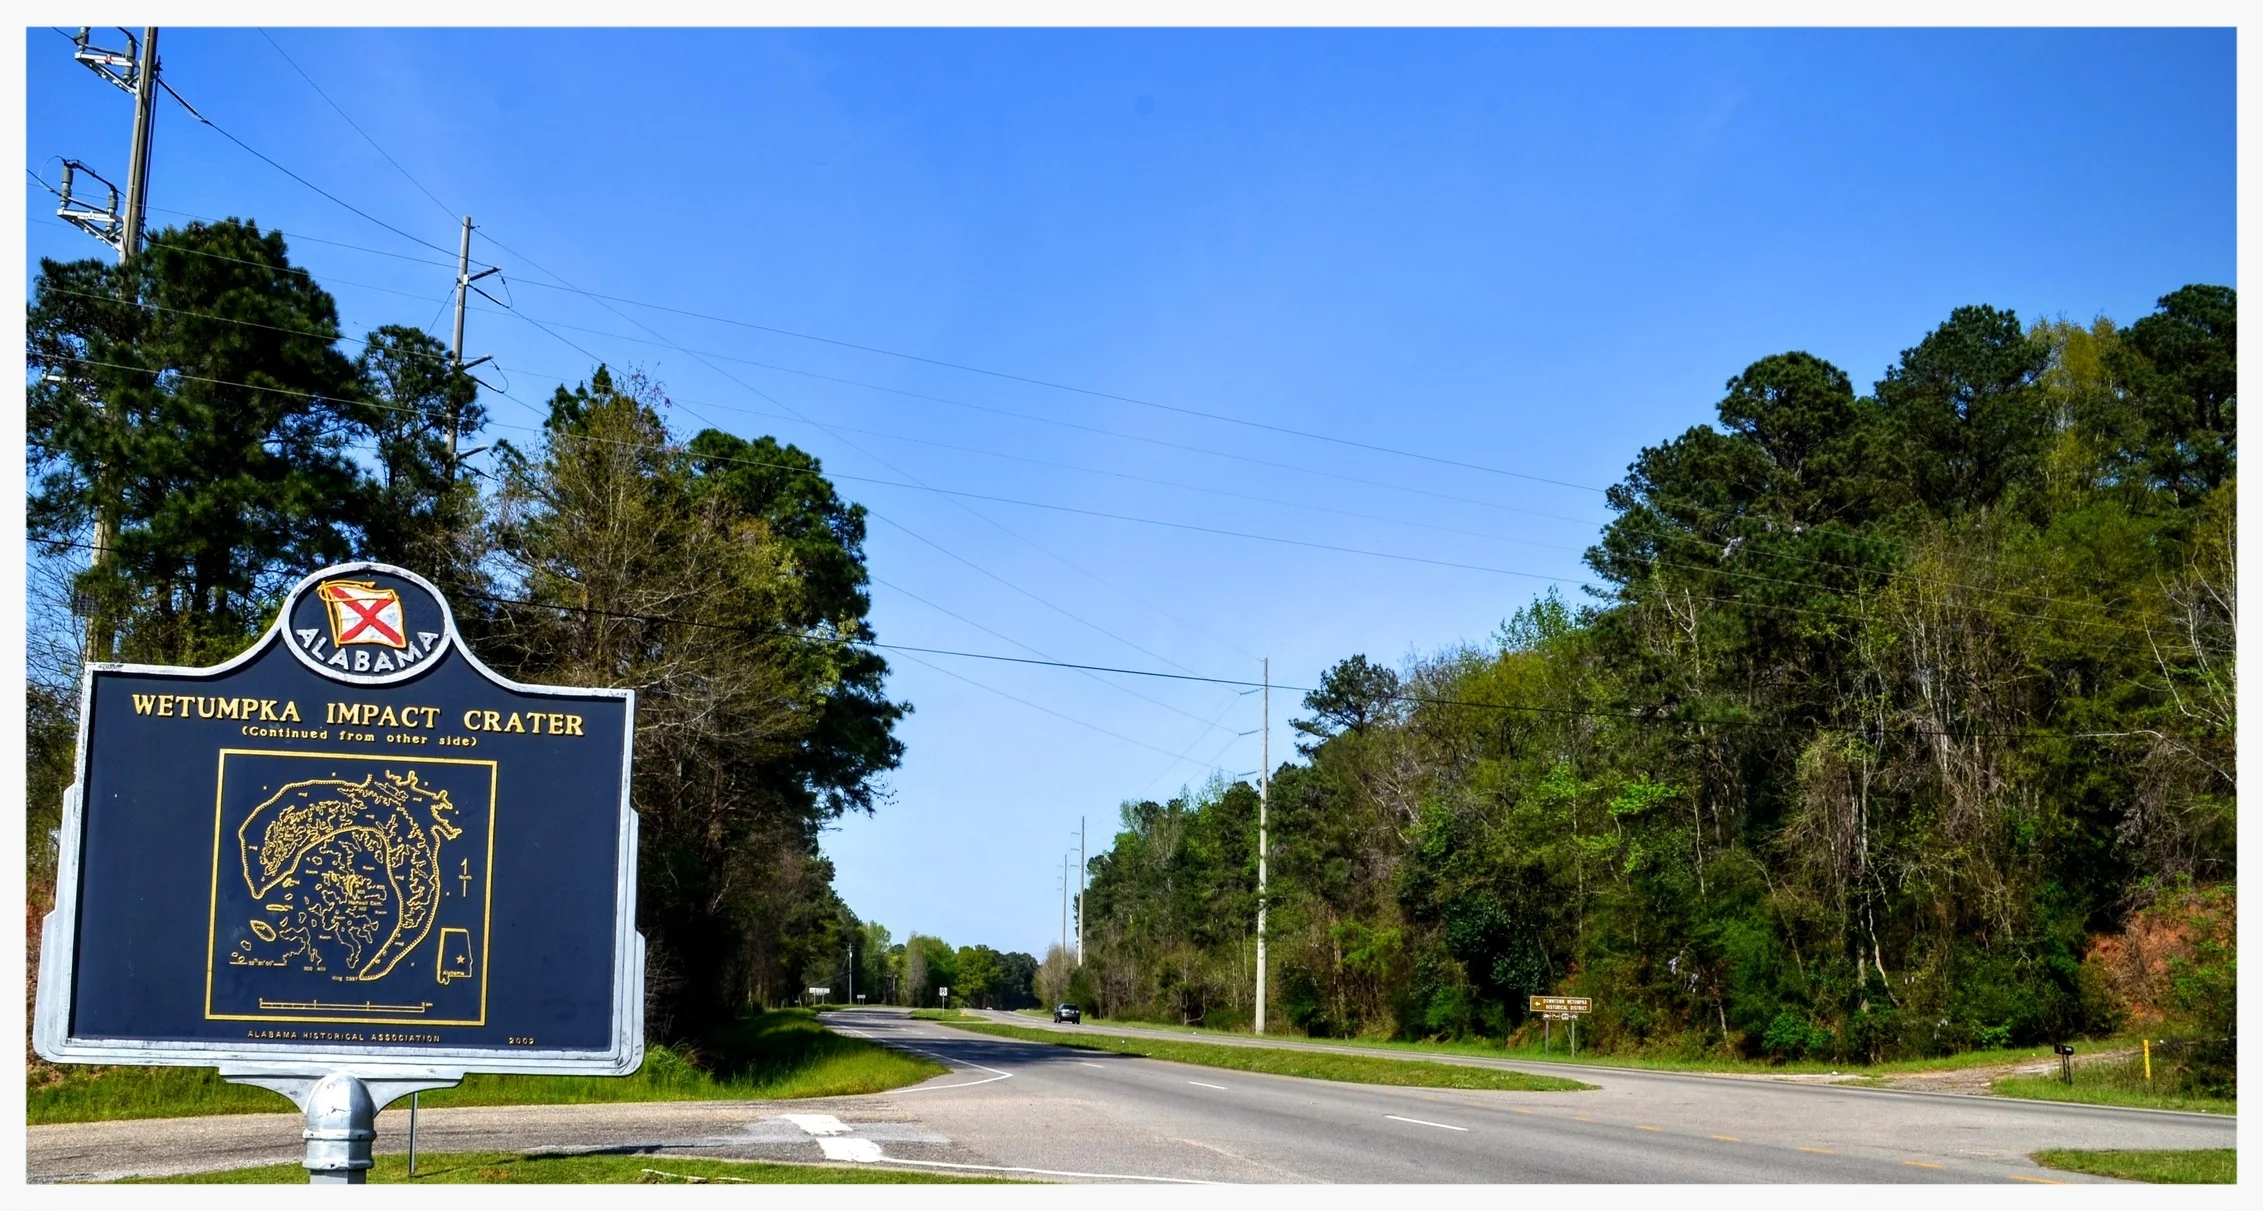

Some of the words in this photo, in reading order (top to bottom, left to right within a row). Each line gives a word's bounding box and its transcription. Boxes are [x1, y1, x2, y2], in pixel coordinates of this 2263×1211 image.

[295, 628, 439, 672] ALABAMA
[132, 693, 302, 723] WETUMPKA
[326, 702, 440, 729] IMPACT
[463, 709, 585, 737] CRATER
[241, 725, 328, 740] (Continued
[339, 730, 375, 742] from
[386, 734, 428, 745] other
[439, 735, 478, 747] side)
[247, 1029, 298, 1039] ALABAMA
[302, 1031, 365, 1042] HISTORICAL
[370, 1033, 441, 1043] ASSOCIATION
[508, 1036, 535, 1045] 2002
